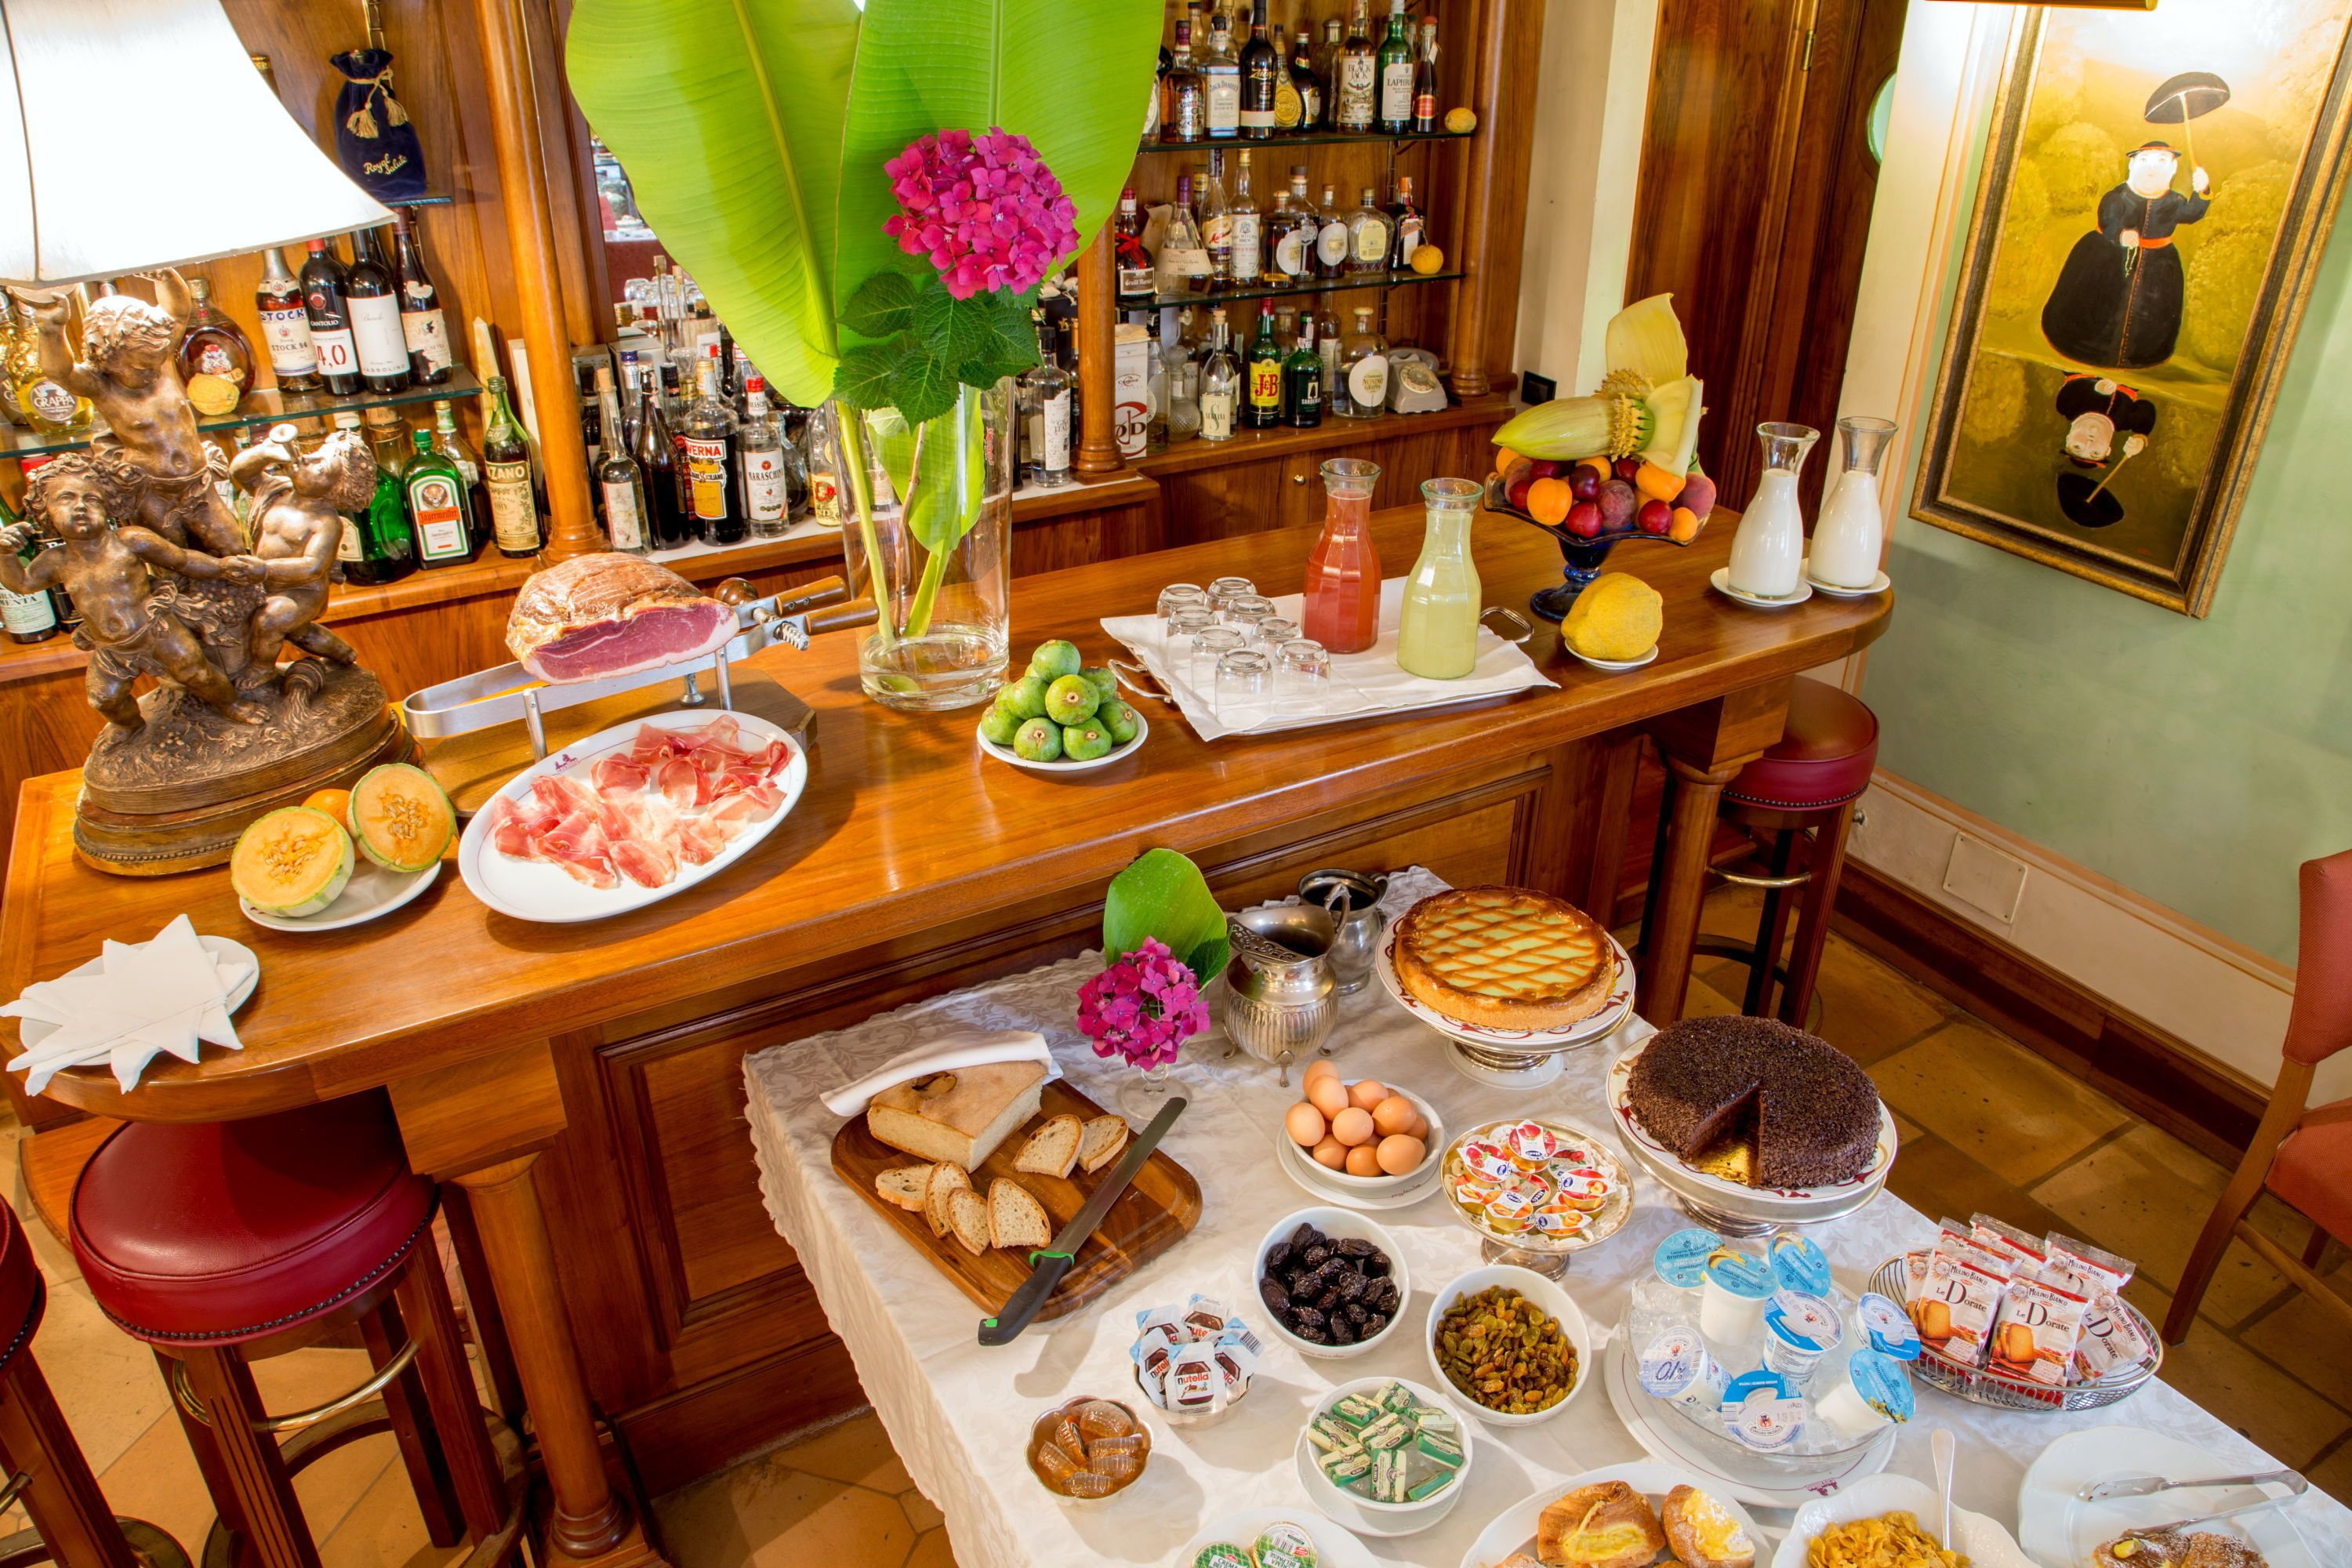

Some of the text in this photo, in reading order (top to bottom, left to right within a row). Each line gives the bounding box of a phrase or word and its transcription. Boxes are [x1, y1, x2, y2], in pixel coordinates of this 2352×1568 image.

[364, 153, 390, 174] Royal
[385, 154, 408, 175] Salute
[262, 308, 304, 321] STOCK
[34, 394, 75, 408] GRAPPA
[1950, 1265, 1987, 1286] MULINO BIANCO
[2087, 1265, 2105, 1280] BIANCO
[2029, 1287, 2068, 1306] MULINO BIANCO
[1150, 1357, 1169, 1377] nutell
[1177, 1372, 1209, 1385] nutella
